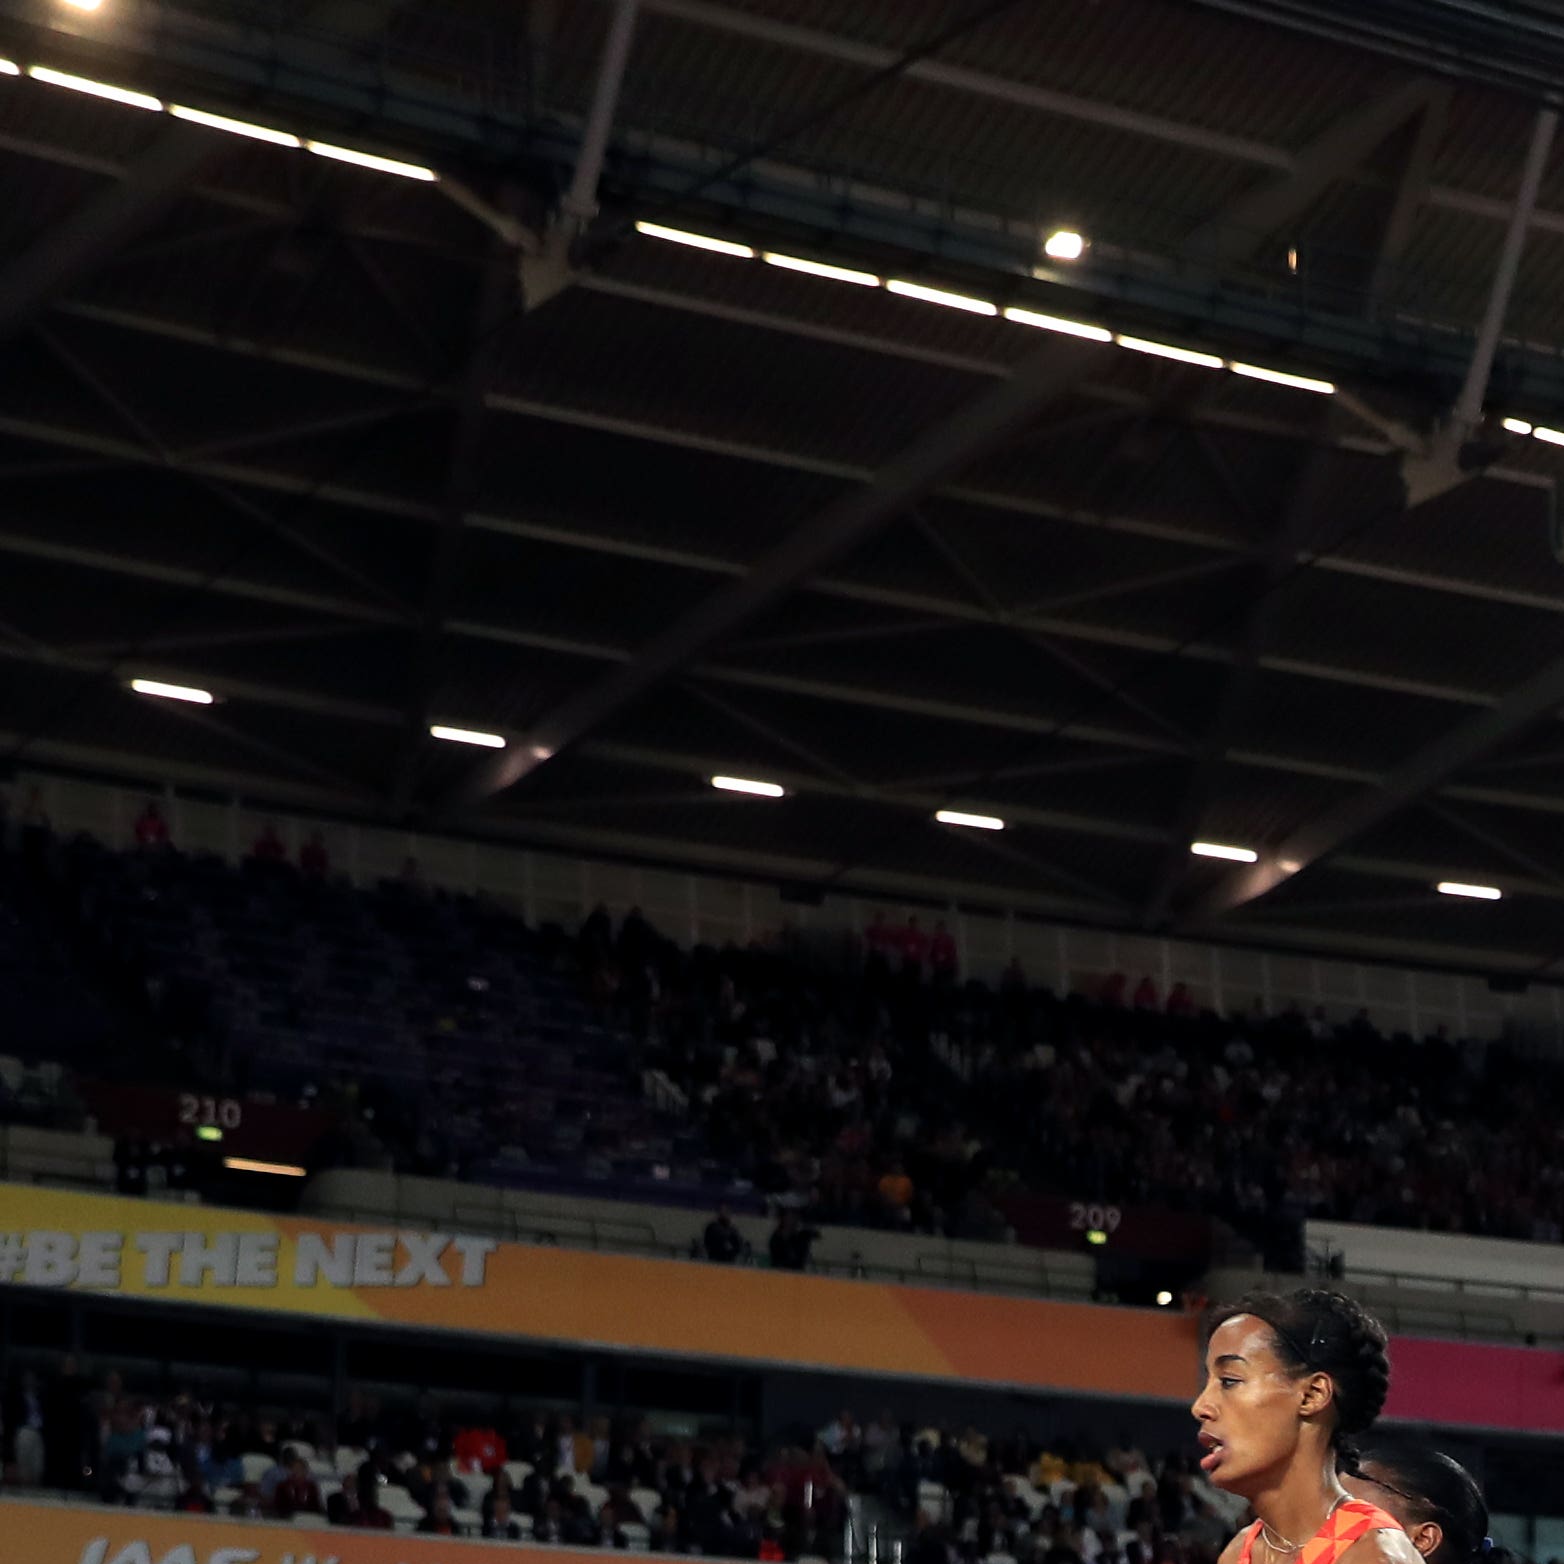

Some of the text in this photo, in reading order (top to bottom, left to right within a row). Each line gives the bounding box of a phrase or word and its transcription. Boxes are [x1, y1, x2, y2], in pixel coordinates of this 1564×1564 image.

[178, 1093, 242, 1128] 210
[1068, 1202, 1122, 1233] 209
[136, 1232, 280, 1287] THE
[294, 1232, 496, 1287] NEXT
